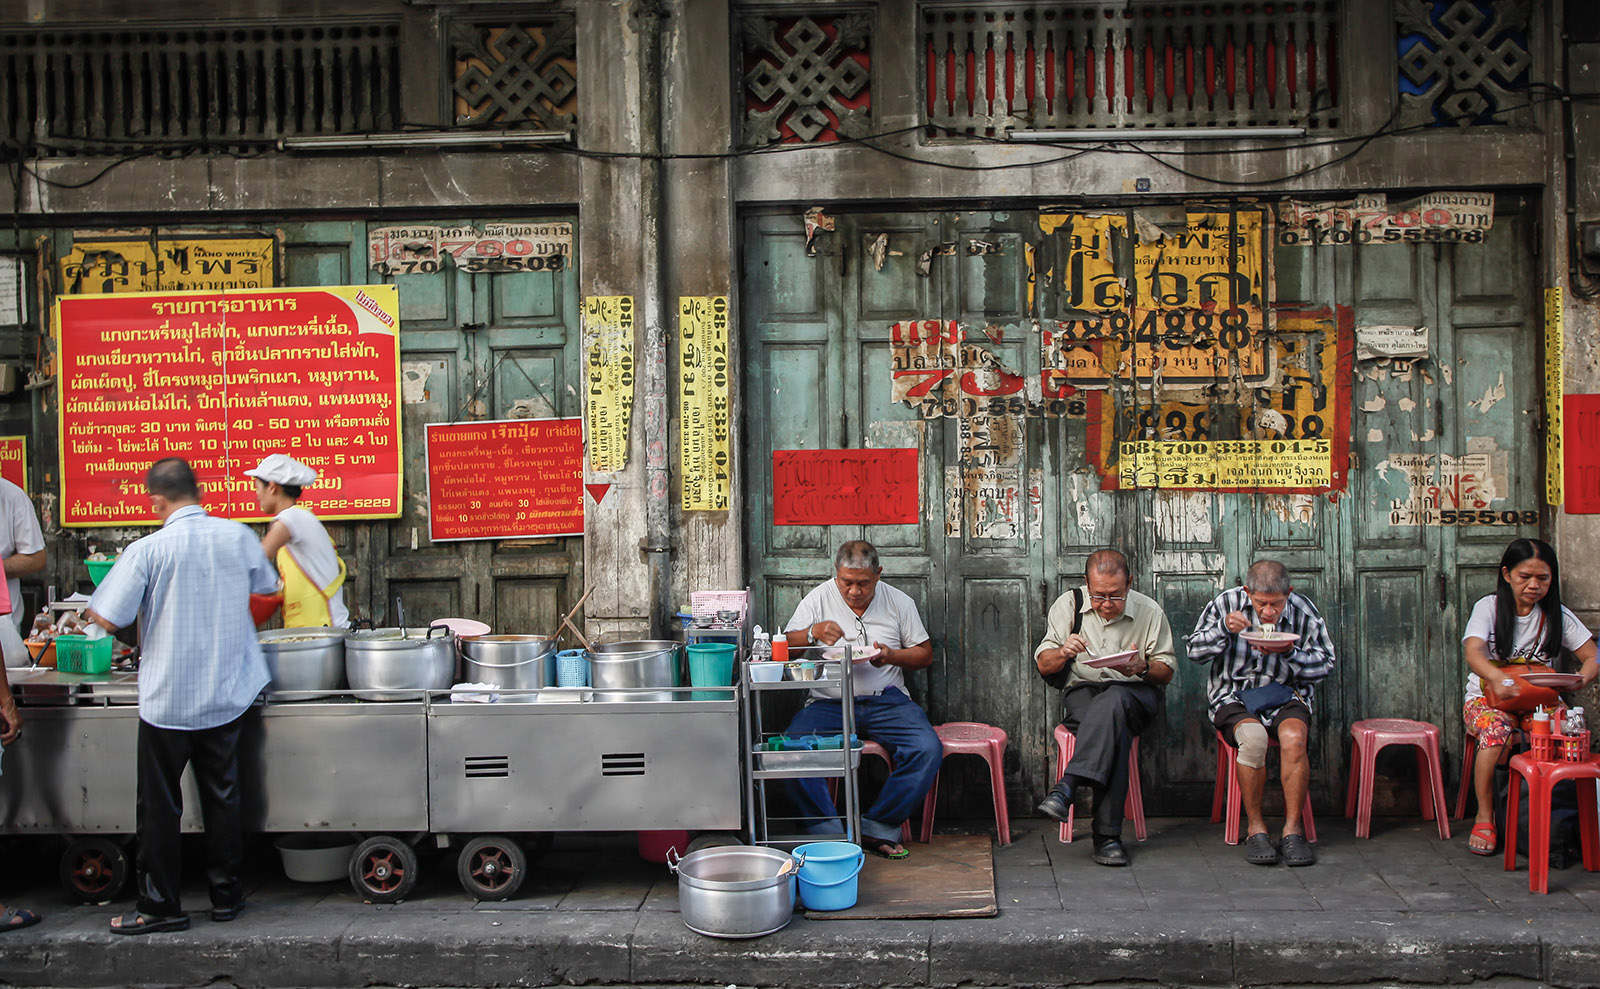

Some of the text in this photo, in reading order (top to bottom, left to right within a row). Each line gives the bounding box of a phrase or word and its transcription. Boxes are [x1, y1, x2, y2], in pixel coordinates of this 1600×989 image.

[1454, 213, 1488, 226] บาท
[440, 240, 534, 257] 700
[536, 242, 568, 254] บาท
[152, 298, 297, 315] รายการอาหาร
[101, 314, 352, 344] แกงกะหรี่หมูใส่ฟัก, แกงกะหรี่เนื้อ,
[76, 340, 379, 366] แกงเขียวหวานไก่, ลูกชิ้นปลากรายใส่ฟัก,
[683, 298, 705, 396] รั่วซึม
[1173, 357, 1198, 370] หนู
[71, 367, 379, 393] ผัดเผ็ดปู, ซี่โครงหมูอบพริกเผา, หมูหวาน,
[66, 391, 392, 413] ผัดเผ็ดหน่อไม้ไก่, ปีกไก่เหล้าแดง, แพนงหมู,
[714, 298, 727, 509] 08-700 333 04-5
[69, 421, 136, 437] กับข้าวถุงละ
[140, 422, 161, 433] 30
[166, 423, 190, 432] บาท
[195, 419, 227, 432] พิเศษ
[232, 419, 253, 430] 40
[269, 418, 290, 429] 50
[295, 419, 320, 429] บาท
[325, 411, 390, 428] หรือตามสั่ง
[72, 440, 102, 453] ไข่ต้ม
[117, 437, 160, 452] ไข่พะโล้
[162, 437, 193, 452] ใบละ
[199, 439, 217, 450] 10
[222, 438, 248, 449] บาท
[252, 438, 286, 451] (ถุงละ
[291, 436, 301, 447] 2
[305, 433, 321, 446] ใบ
[326, 436, 348, 446] และ
[353, 434, 364, 445] 4
[368, 431, 388, 446] ใบ)
[1121, 441, 1329, 455] 08-700 333 04-5
[334, 454, 345, 465] 5
[350, 454, 376, 465] บาท
[572, 470, 583, 479] 10
[1276, 468, 1292, 479] หนู
[1294, 463, 1323, 476] จิ้งจก
[71, 499, 146, 519] สั่งใส่ถุงโทร.
[470, 500, 481, 509] 30
[518, 499, 529, 508] 30
[458, 514, 468, 523] 10
